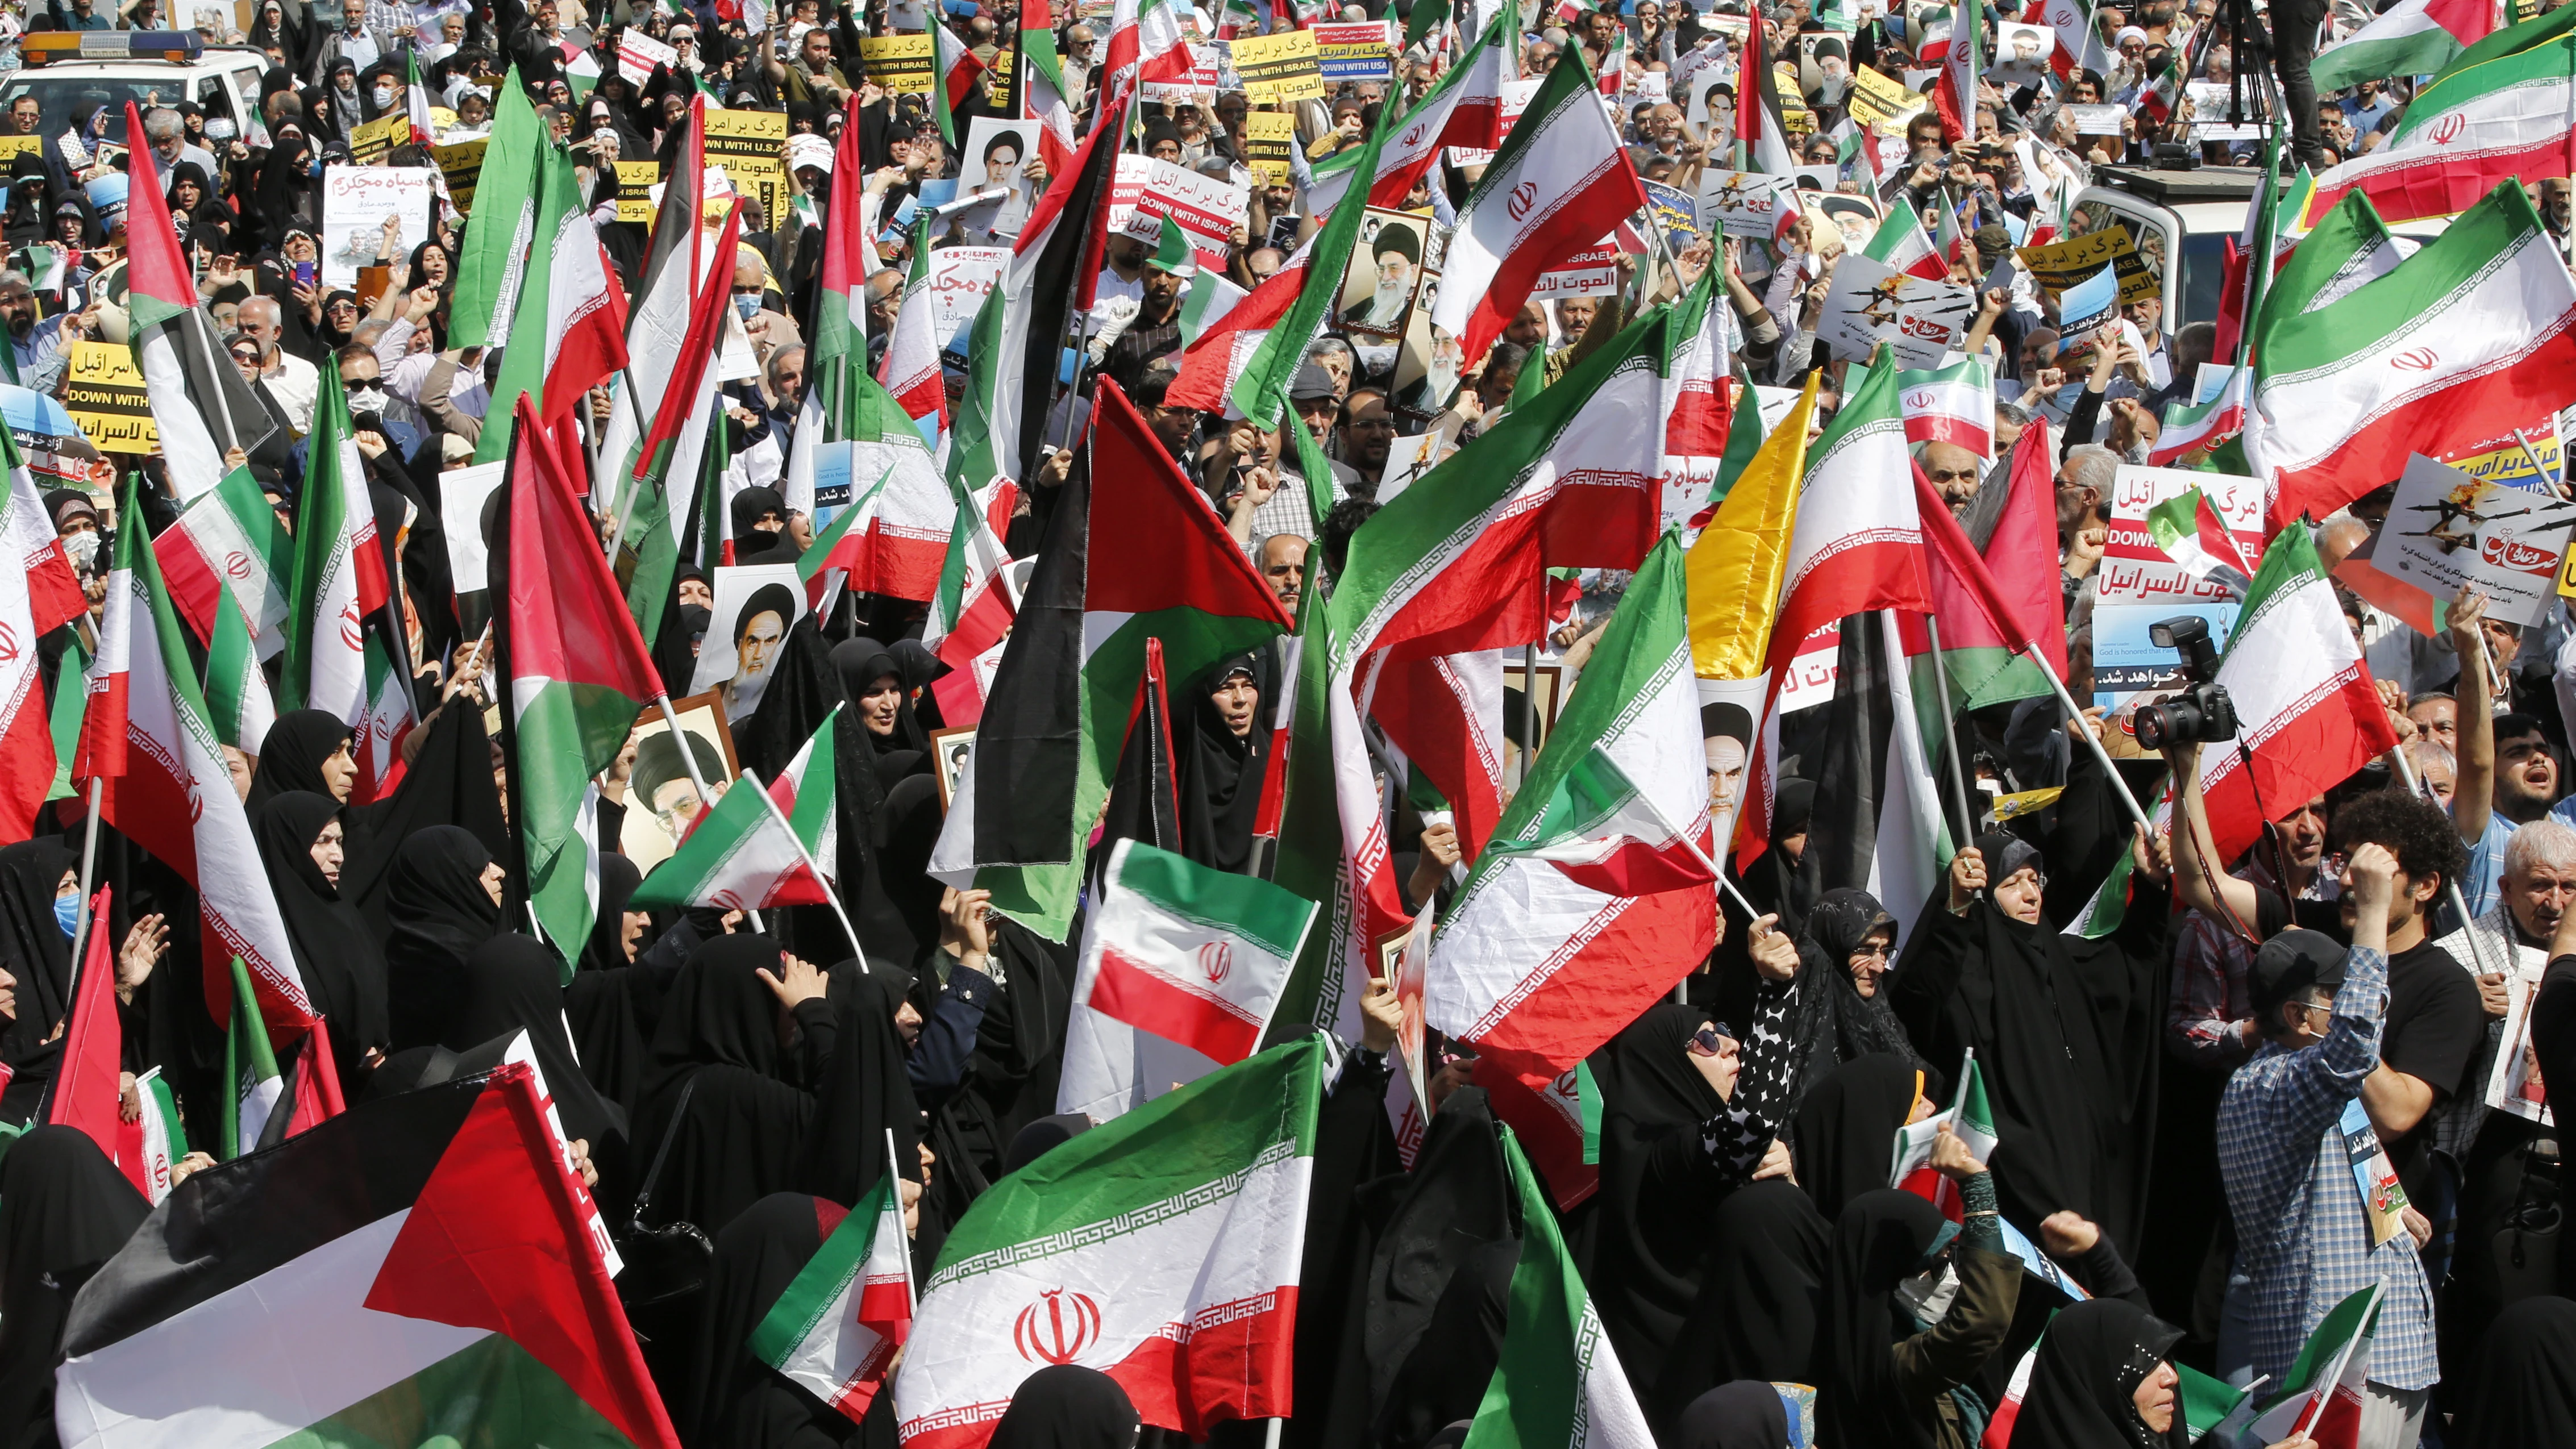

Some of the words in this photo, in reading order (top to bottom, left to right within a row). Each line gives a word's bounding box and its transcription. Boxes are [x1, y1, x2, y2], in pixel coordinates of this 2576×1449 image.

[624, 34, 648, 50] اسرائیل
[863, 42, 888, 57] اسرائیل
[905, 39, 929, 54] مرگ
[1285, 37, 1312, 53] مرگ
[891, 45, 901, 56] بر
[1234, 43, 1268, 62] اسرائیل
[1272, 45, 1281, 57] بر
[1351, 48, 1361, 57] بر
[1363, 45, 1388, 56] مرگ
[620, 49, 636, 62] DOWN
[636, 57, 652, 68] WITH
[1194, 51, 1215, 66] مرگ
[1346, 62, 1370, 70] WITH
[1370, 61, 1387, 70] USA
[1238, 69, 1259, 78] DOWN
[1259, 65, 1282, 76] WITH
[1283, 60, 1318, 73] ISRAEL
[899, 75, 932, 90] الموت
[1186, 73, 1216, 81] ISRAEL
[1860, 70, 1886, 91] امریکا
[1284, 77, 1321, 96] الموت
[1854, 87, 1876, 105] DOWN
[1877, 100, 1897, 115] WITH
[1887, 91, 1896, 101] بر
[352, 126, 376, 143] امریکا
[378, 127, 385, 138] بر
[736, 123, 748, 136] بر
[754, 119, 783, 136] مرگ
[1262, 124, 1270, 138] بر
[1273, 119, 1291, 138] مرگ
[725, 141, 752, 151] WITH
[1273, 146, 1291, 156] U.S.A
[631, 165, 655, 182] مرگ
[741, 161, 780, 177] الموت
[332, 171, 382, 198] مچکریم
[386, 172, 423, 195] سپاه
[1151, 170, 1200, 196] اسرائیل
[1197, 193, 1213, 207] بر
[1216, 192, 1243, 215] مرگ
[1139, 195, 1172, 215] DOWN
[1175, 207, 1200, 224] WITH
[1201, 217, 1231, 235] ISRAE
[2091, 236, 2126, 254] مرگ
[2025, 249, 2070, 268] اسرائیل
[2076, 250, 2090, 264] بر
[1563, 272, 1614, 293] الموت
[2102, 305, 2113, 319] آزاد
[2061, 323, 2075, 335] شد.
[2076, 313, 2102, 330] خواهد
[75, 352, 134, 380] اسرائیل
[943, 356, 961, 365] شد.
[68, 389, 112, 405] DOWN
[115, 393, 149, 408] WITH
[13, 432, 45, 447] خواهد
[47, 437, 64, 451] آزاد
[2499, 457, 2517, 476] بر
[1674, 456, 1714, 500] سپاه
[817, 488, 838, 502] شد.
[2218, 485, 2257, 522] مرگ
[2108, 529, 2158, 549] DOWN
[2415, 553, 2431, 563] اشتباه
[2430, 560, 2445, 571] ایران
[2432, 573, 2452, 587] خواهد
[2443, 567, 2474, 581] کنسولگری
[2451, 582, 2461, 590] هم
[2480, 578, 2494, 587] حمله
[2497, 582, 2528, 596] صهیونیستی
[2527, 590, 2540, 599] رژیم
[2098, 669, 2124, 685] شد.
[2127, 667, 2179, 689] خواهد
